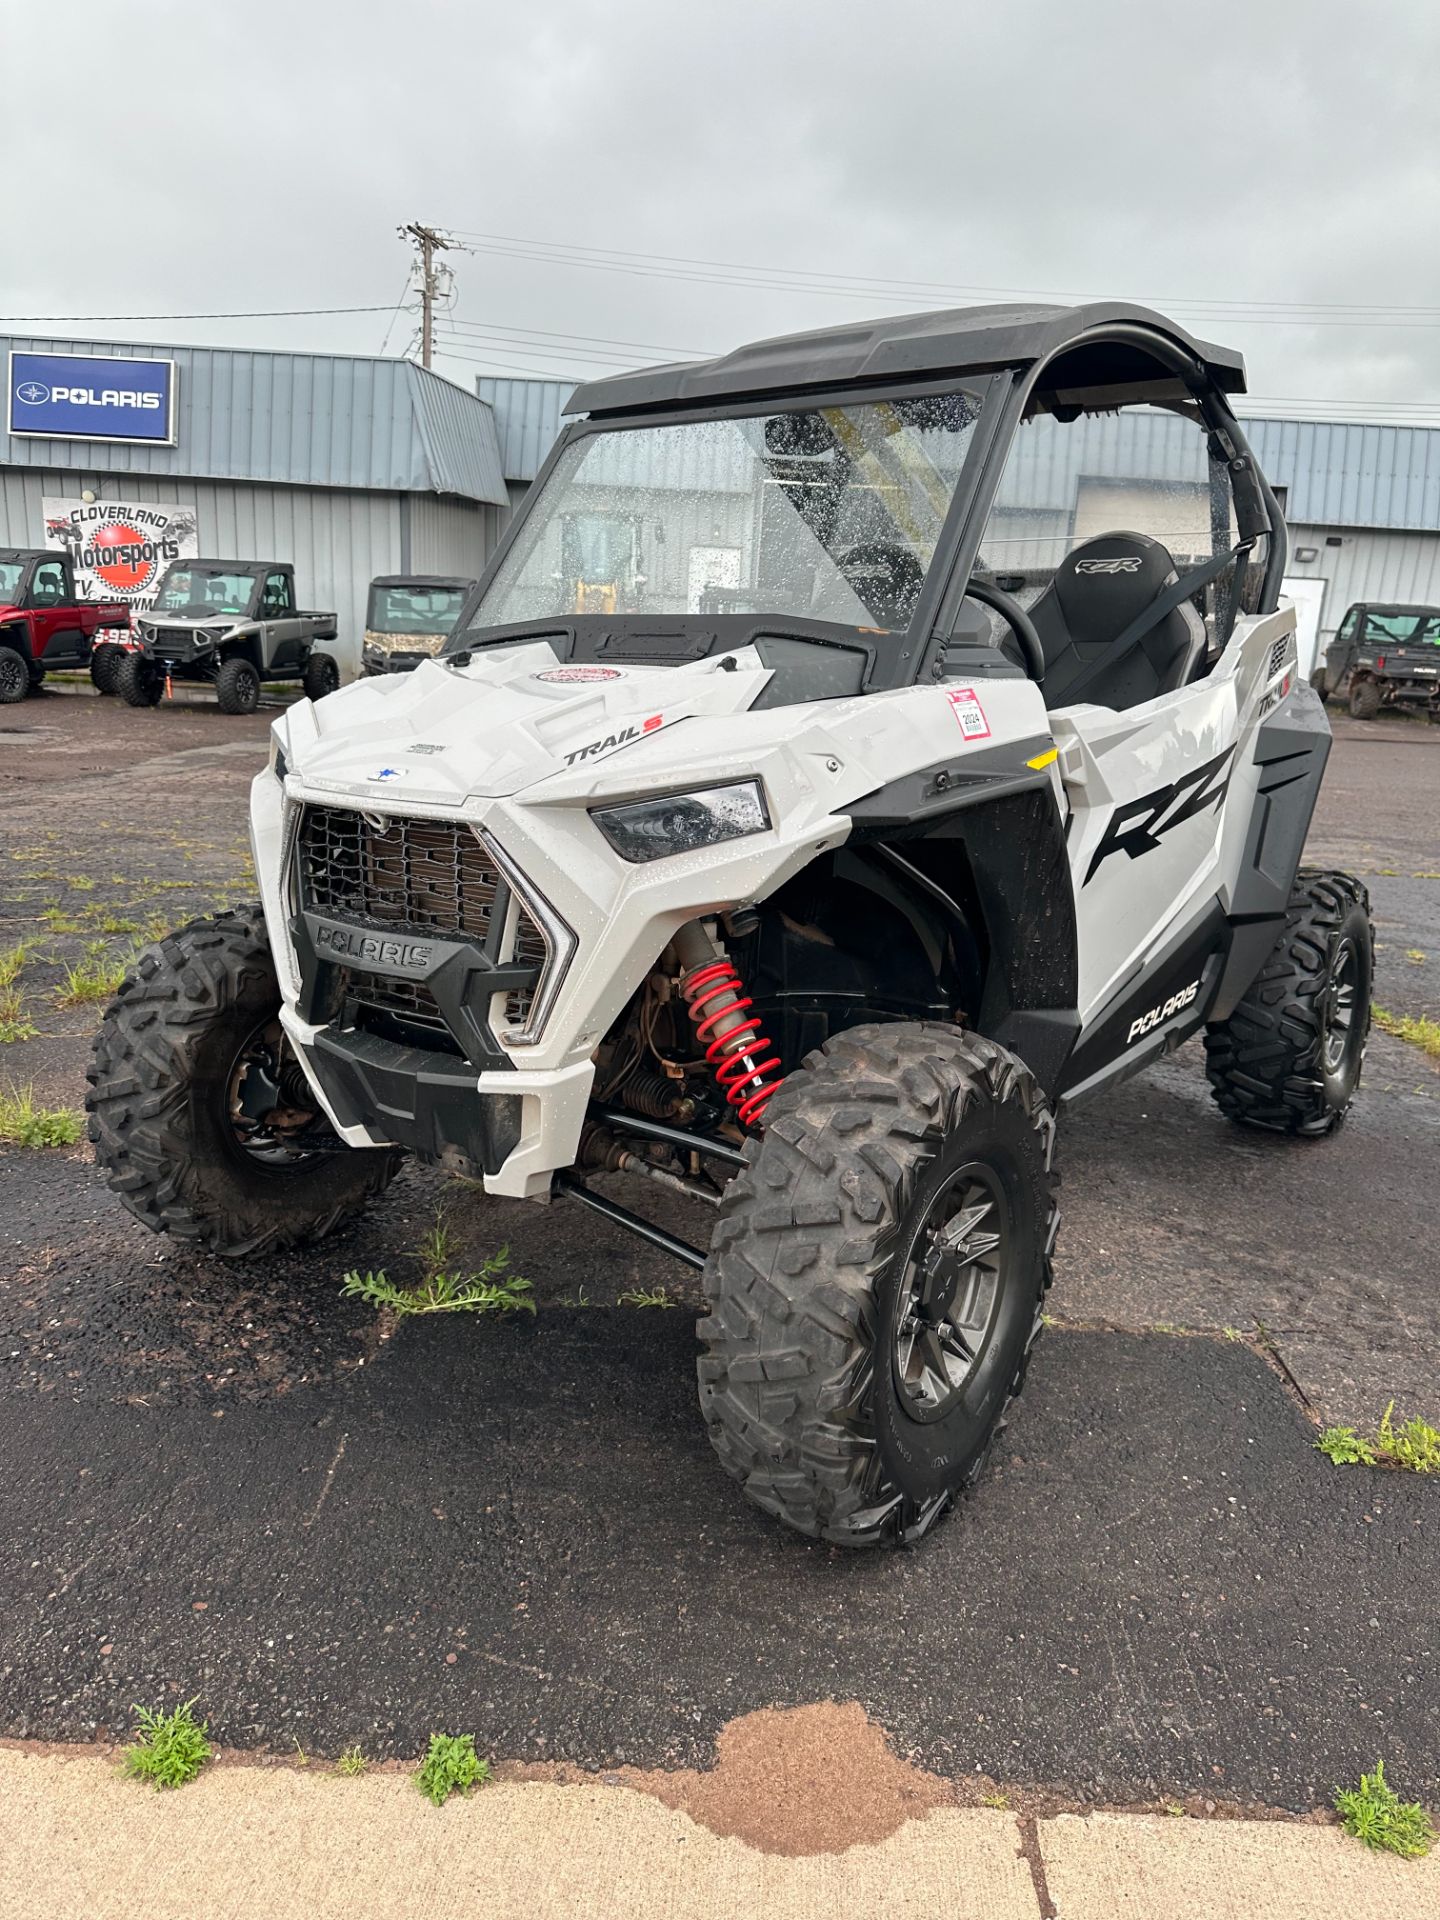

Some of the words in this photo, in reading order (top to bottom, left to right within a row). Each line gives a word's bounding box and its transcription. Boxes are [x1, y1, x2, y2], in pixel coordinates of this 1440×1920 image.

[51, 387, 160, 409] POLARIS
[70, 505, 168, 529] CLOVERLAND
[67, 535, 179, 573] Motorsports
[1075, 557, 1143, 574] RZR
[962, 713, 980, 725] 2024
[563, 726, 641, 767] TRAIL
[642, 713, 664, 734] S
[315, 925, 433, 968] POLARIS
[1126, 980, 1199, 1044] POLARIS
